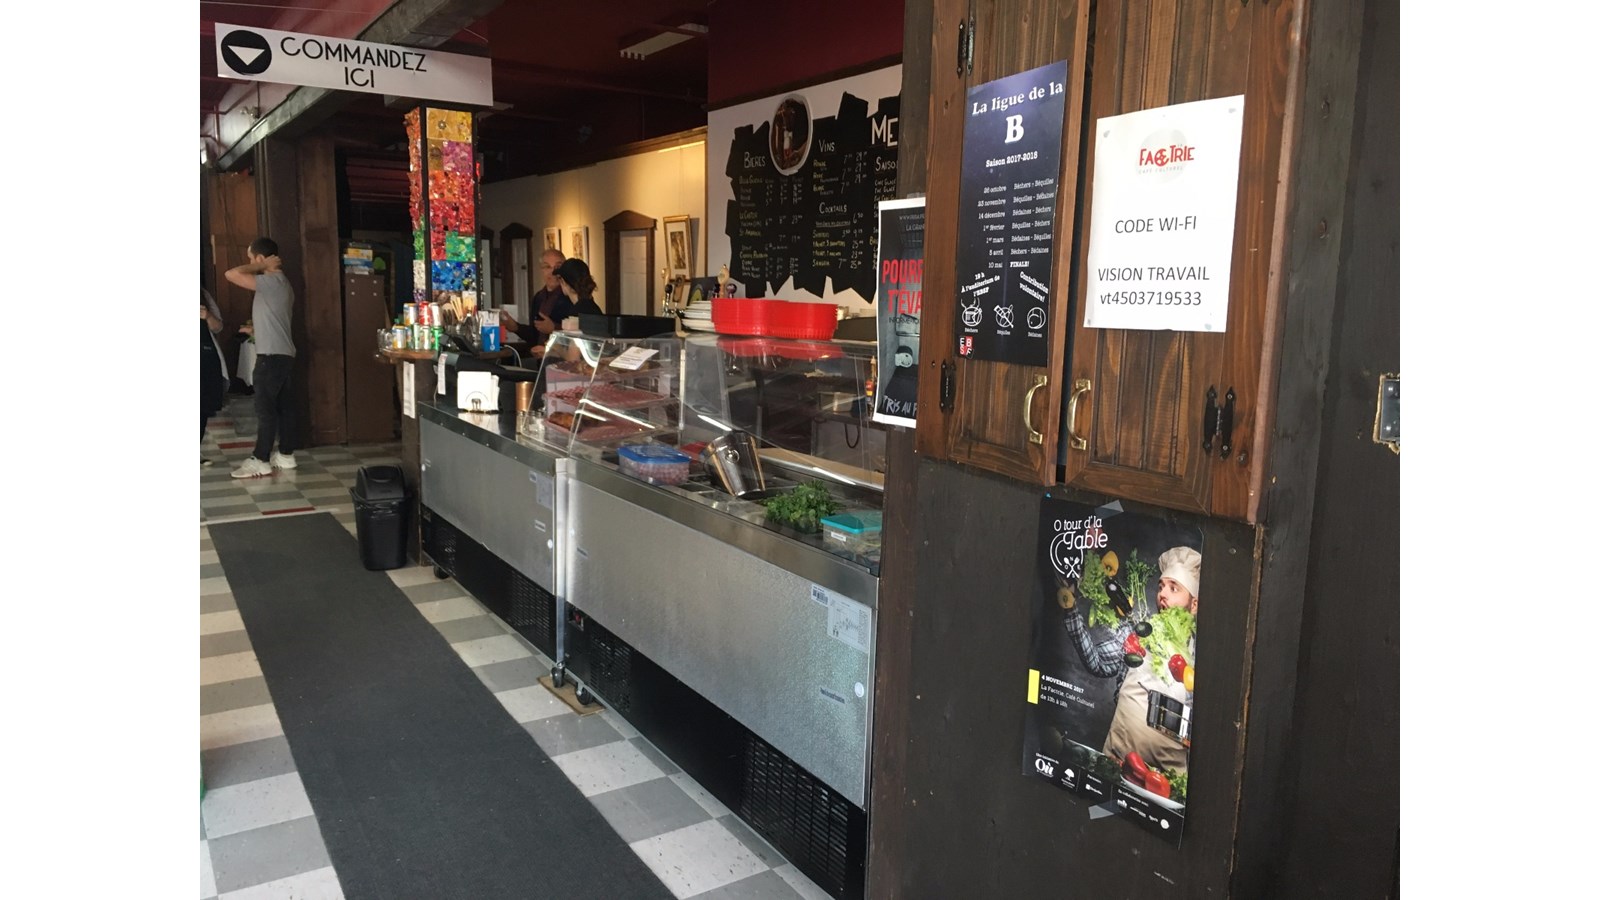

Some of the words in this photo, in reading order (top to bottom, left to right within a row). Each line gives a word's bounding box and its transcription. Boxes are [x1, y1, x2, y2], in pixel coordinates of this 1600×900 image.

[280, 37, 427, 72] COMMANDEZ
[345, 67, 374, 88] ICI
[972, 101, 987, 116] La
[991, 93, 1025, 112] ligue
[1028, 86, 1045, 101] de
[1049, 81, 1063, 96] la
[871, 115, 898, 147] ME
[1004, 114, 1024, 145] B
[985, 158, 1005, 168] Saison
[1006, 150, 1038, 165] 2017-2018
[990, 185, 1007, 193] octobre
[984, 198, 1006, 206] novembre
[984, 210, 1006, 219] décembre
[1115, 218, 1154, 234] CODE
[1159, 216, 1197, 231] WI-FI
[1020, 271, 1049, 294] Contribution
[1098, 267, 1143, 281] VISION
[1147, 266, 1210, 281] TRAVAIL
[1100, 291, 1202, 306] vt4503719533
[1053, 519, 1062, 532] O
[1063, 519, 1082, 531] tour
[1063, 528, 1108, 550] Table
[1045, 675, 1073, 690] NOVEMBRE
